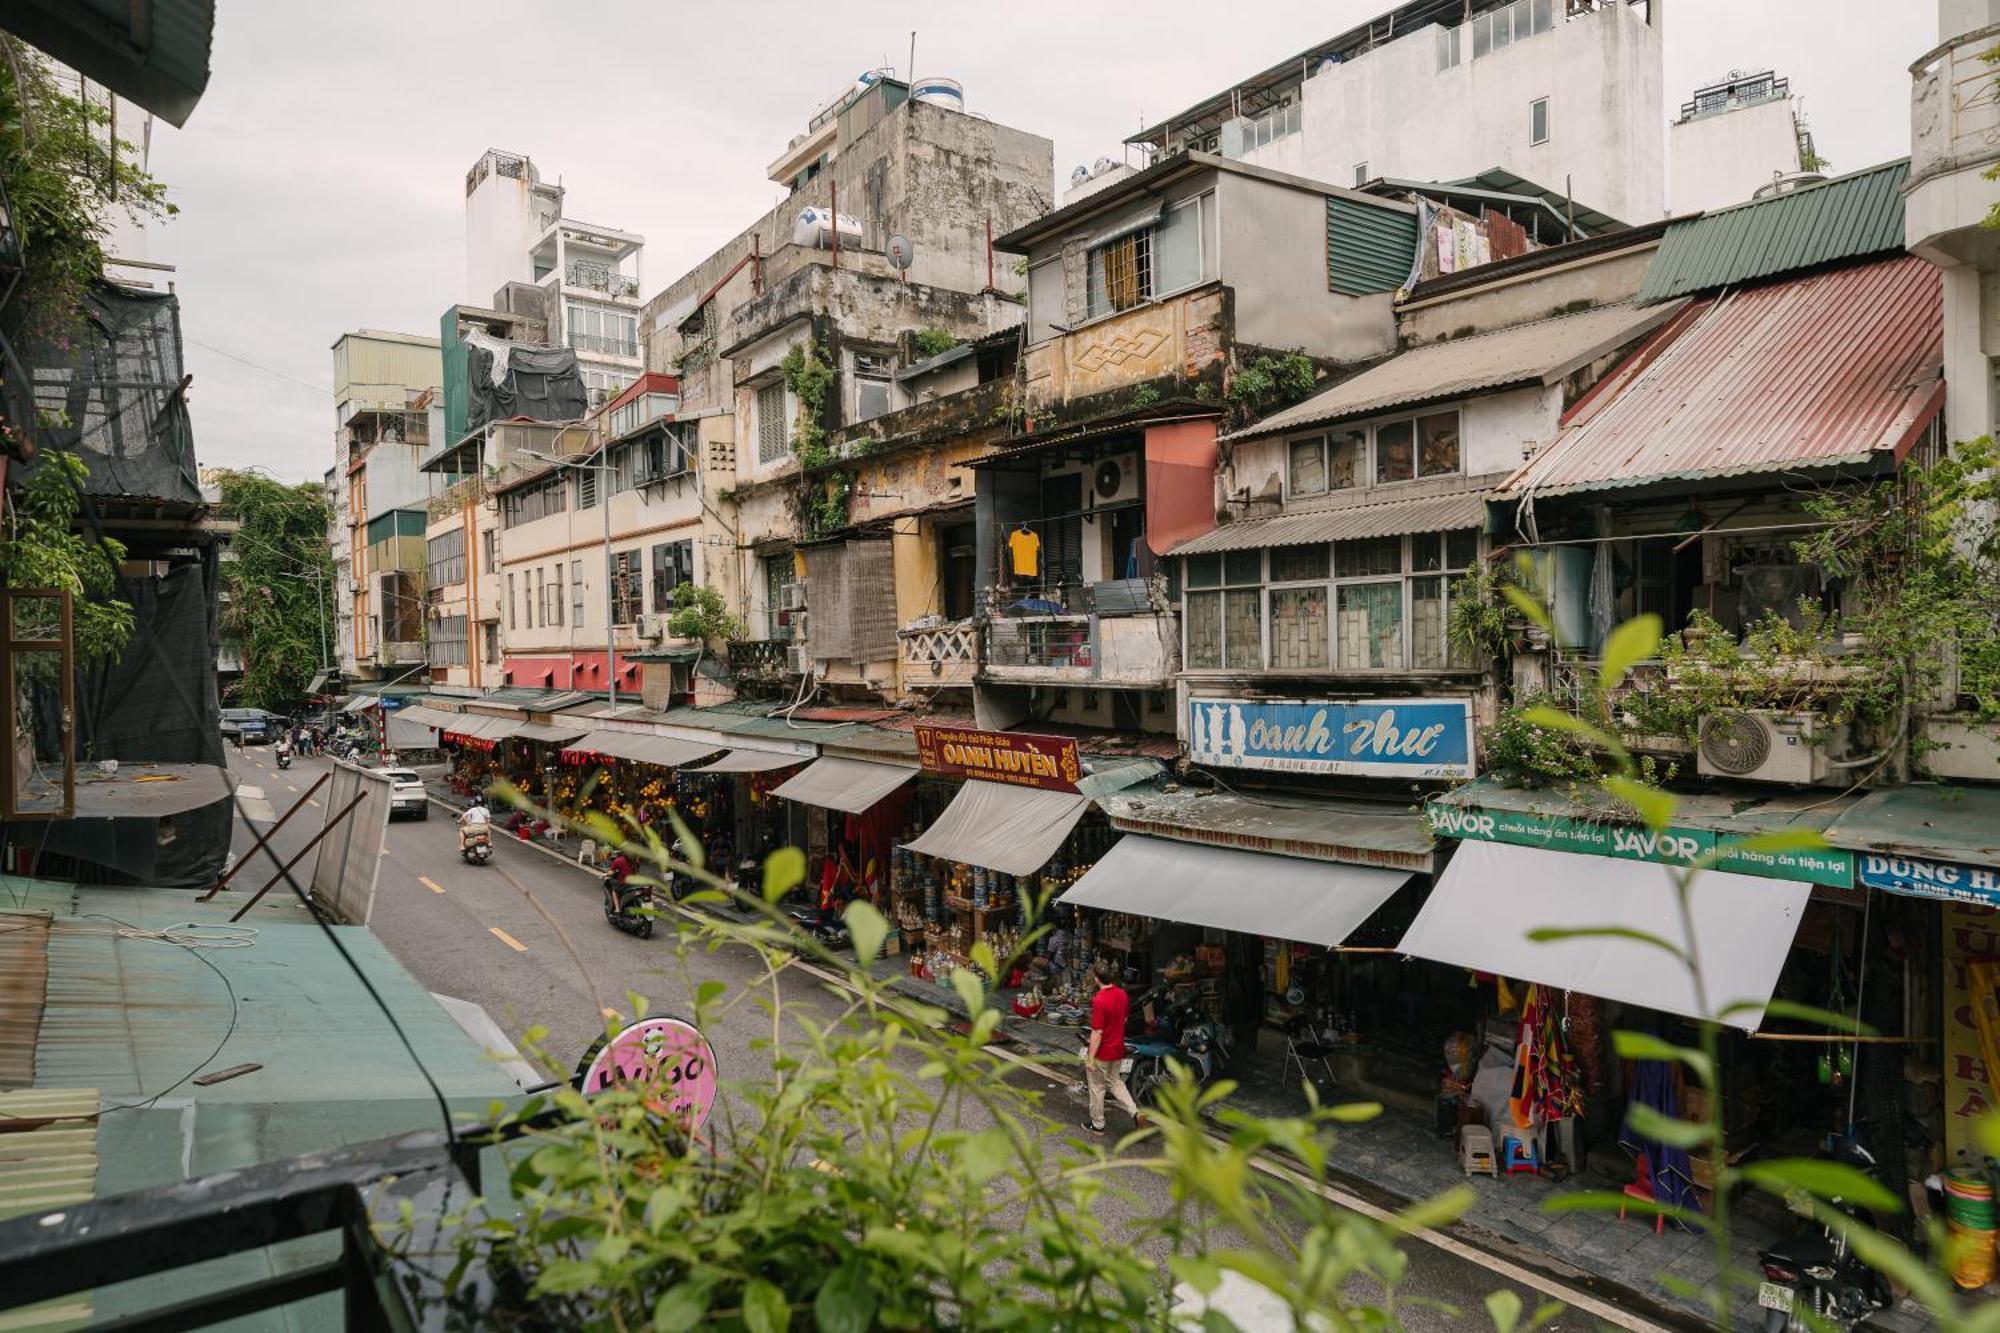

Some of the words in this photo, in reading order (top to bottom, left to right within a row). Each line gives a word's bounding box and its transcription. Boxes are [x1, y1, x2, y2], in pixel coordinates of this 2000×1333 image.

[918, 730, 931, 747] 17
[943, 744, 993, 769] OANH
[994, 742, 1059, 778] HUYỀN
[1429, 807, 1495, 839] SAVOR
[1613, 828, 1700, 864] SAVOR
[1741, 850, 1775, 866] hàng
[1799, 855, 1824, 871] tiện
[1828, 859, 1846, 875] lợi
